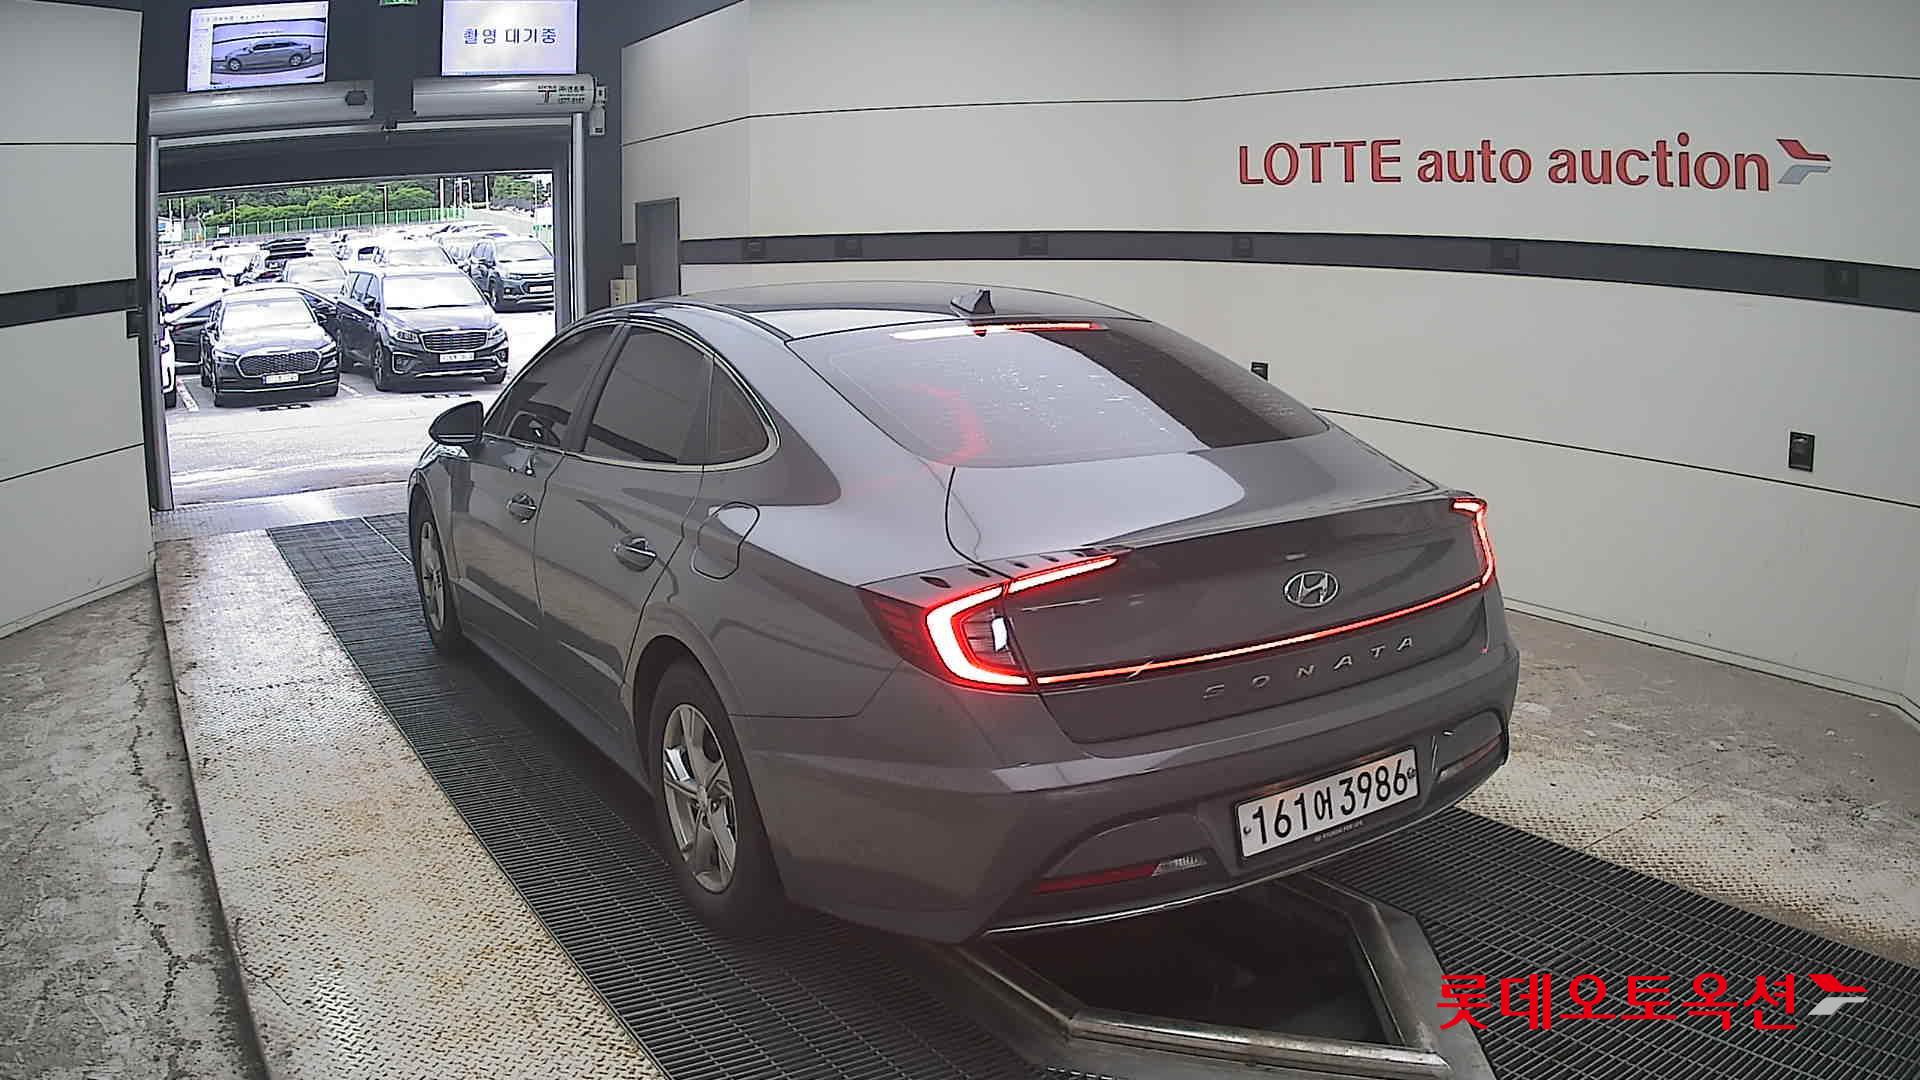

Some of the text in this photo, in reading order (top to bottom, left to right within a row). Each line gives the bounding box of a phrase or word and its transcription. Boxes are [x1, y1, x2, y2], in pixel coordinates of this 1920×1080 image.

[505, 28, 557, 45] 대기중
[1239, 132, 1771, 191] LOTTE auto auction
[1202, 635, 1414, 699] SONATA
